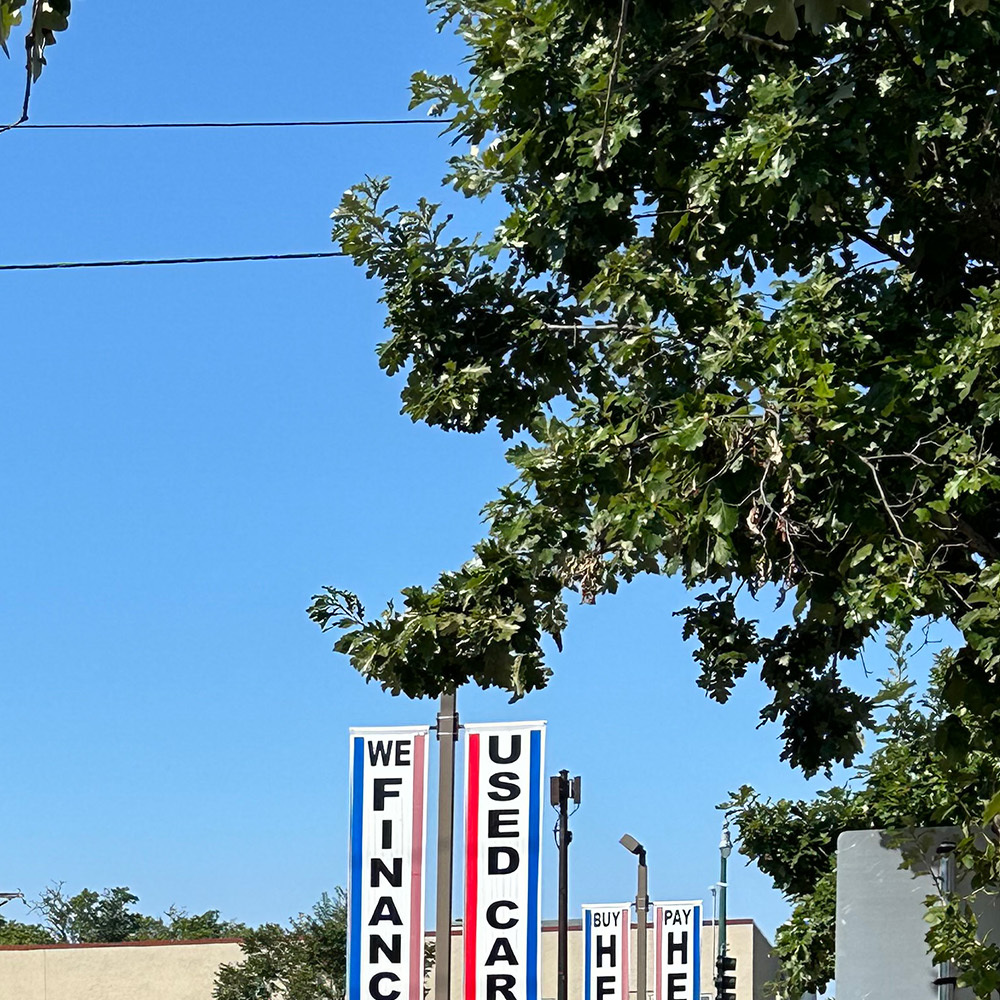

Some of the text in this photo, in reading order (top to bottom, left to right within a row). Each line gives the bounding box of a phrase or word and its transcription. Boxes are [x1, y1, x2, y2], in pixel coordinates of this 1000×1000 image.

[368, 740, 411, 766] WE
[487, 734, 522, 876] USED
[593, 911, 621, 928] BUY
[664, 909, 692, 926] PAY
